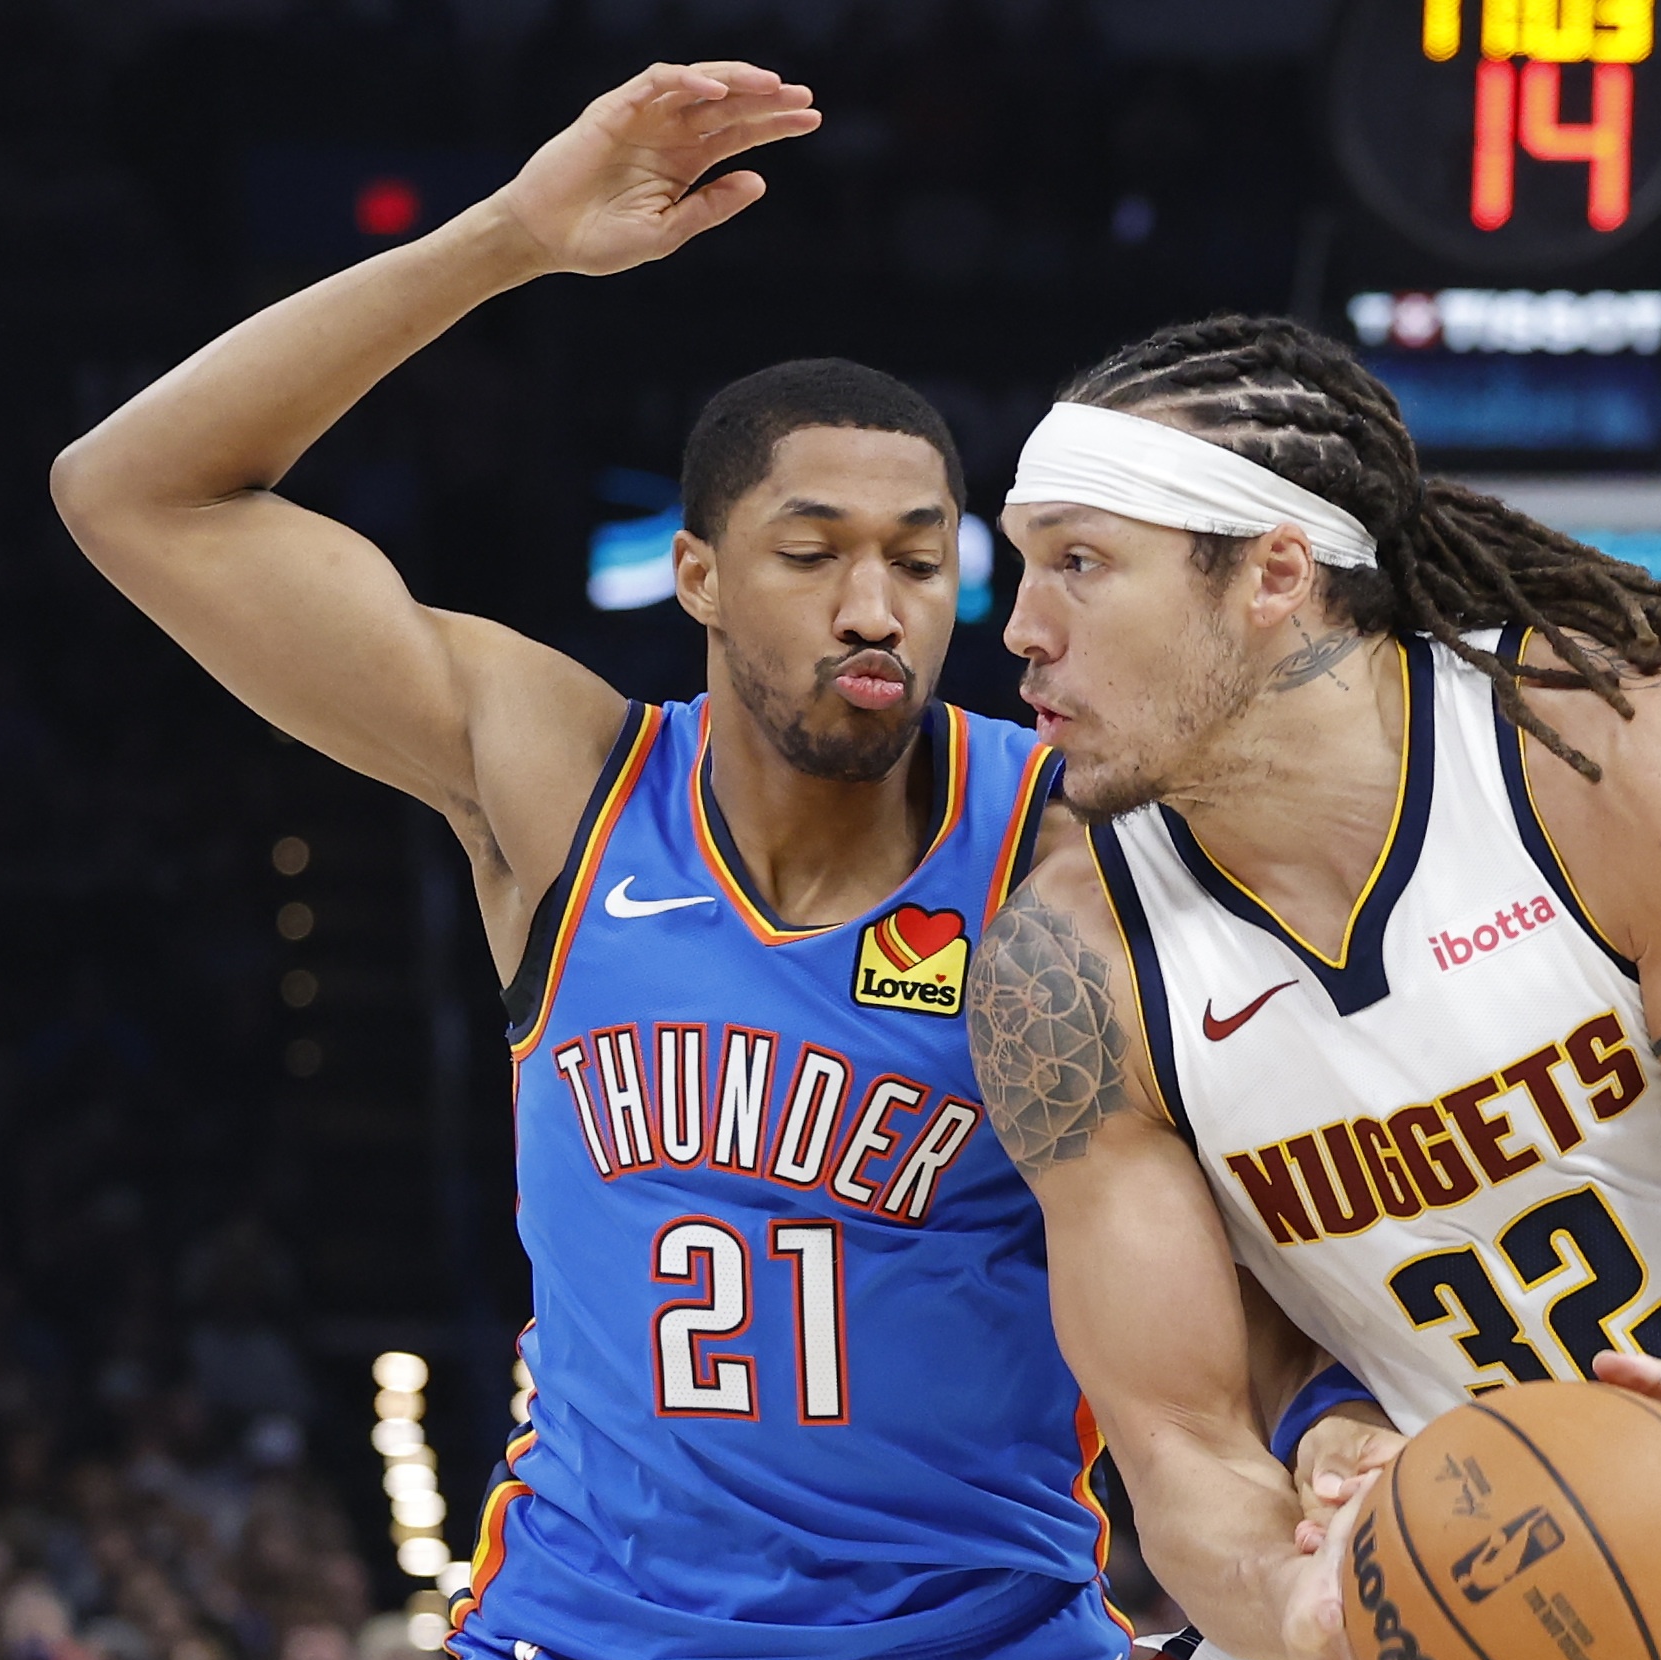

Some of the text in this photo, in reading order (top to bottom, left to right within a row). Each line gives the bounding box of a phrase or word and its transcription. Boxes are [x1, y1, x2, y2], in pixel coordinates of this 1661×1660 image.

[1471, 57, 1634, 231] 14
[1428, 895, 1556, 972] ibotta
[552, 1021, 983, 1225] THUNDER
[1225, 1008, 1648, 1248] NUGGETS
[650, 1213, 850, 1426] 21
